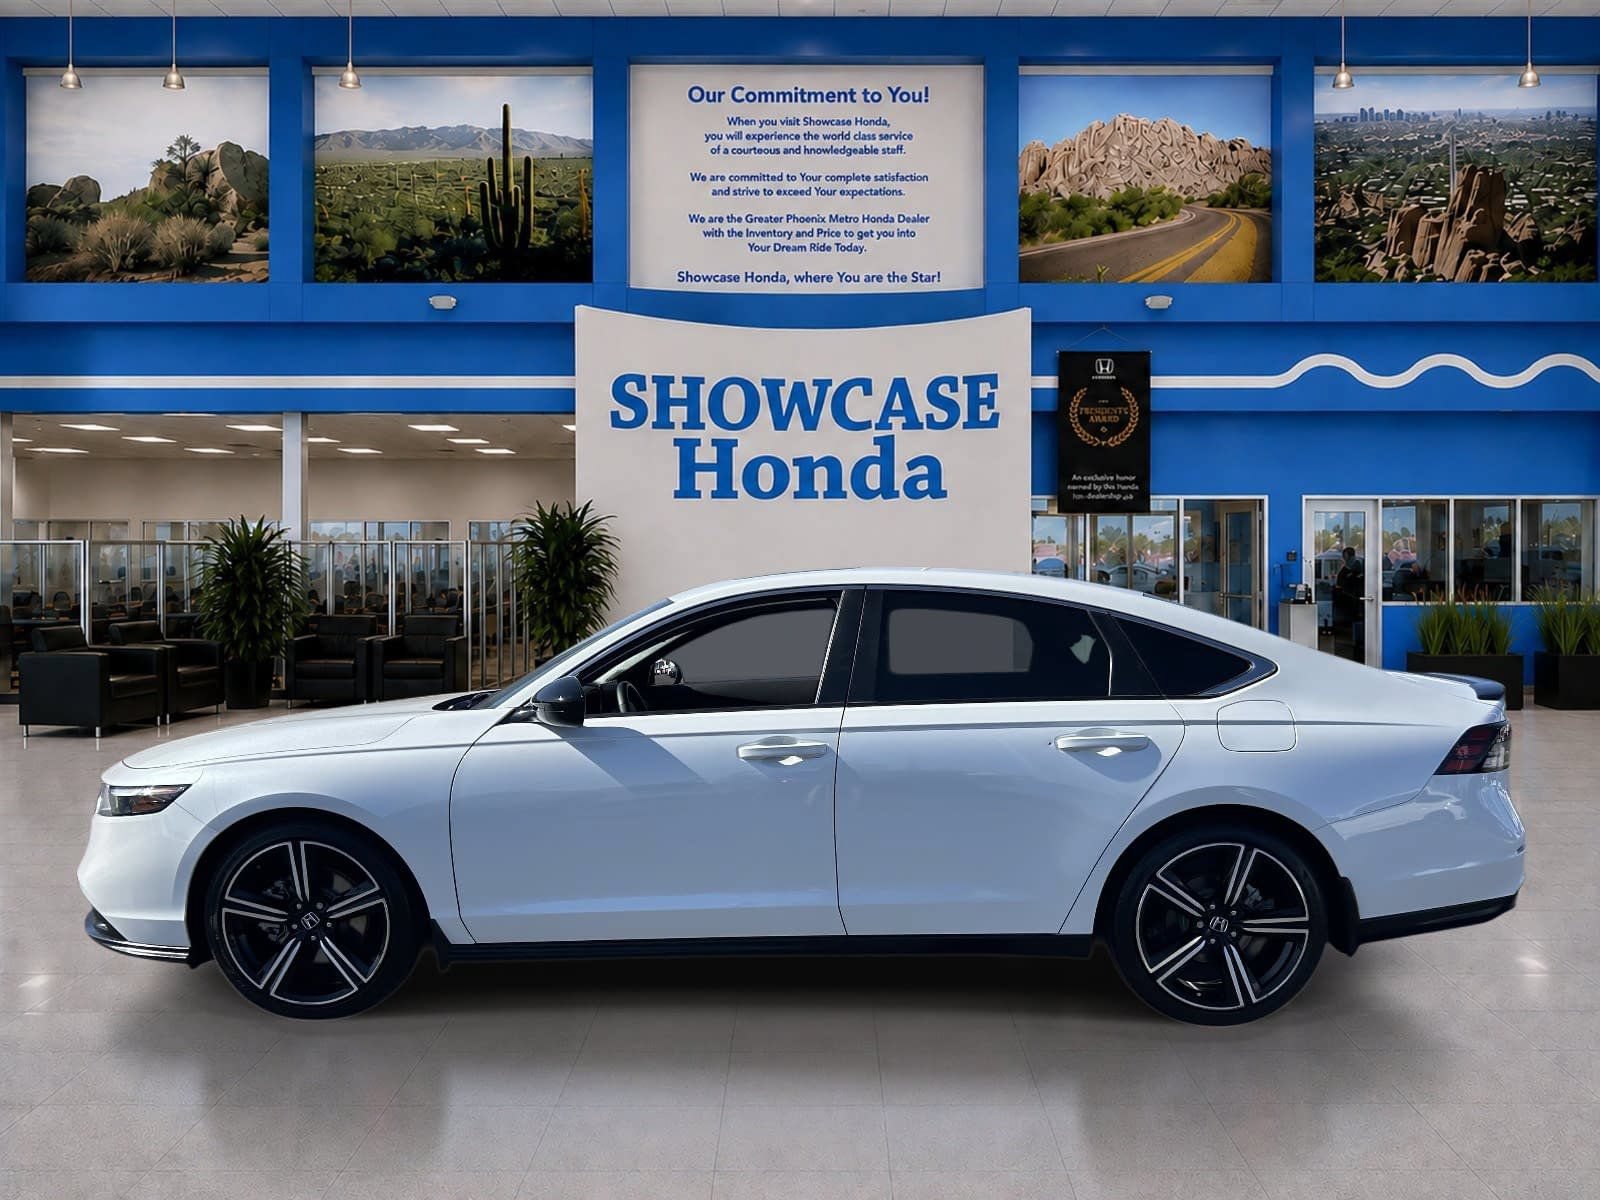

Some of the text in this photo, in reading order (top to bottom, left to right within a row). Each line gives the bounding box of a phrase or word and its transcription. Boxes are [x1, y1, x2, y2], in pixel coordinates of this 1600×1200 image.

[688, 86, 928, 103] Our Commitment to You!
[727, 117, 890, 128] When you visit Showcase Honda,
[705, 131, 913, 143] you will experience the world class service
[710, 145, 720, 154] of
[731, 147, 780, 155] courteous
[783, 145, 801, 154] and
[882, 145, 906, 154] staff.
[690, 173, 707, 182] We
[729, 172, 783, 182] committed
[786, 174, 797, 182] to
[800, 173, 822, 182] Your
[825, 172, 871, 184] complete
[874, 172, 928, 182] satisfaction
[712, 187, 905, 199] and strive to exceed Your expectations.
[689, 214, 706, 224] We
[726, 214, 743, 223] the
[745, 214, 784, 223] Greater
[786, 214, 826, 223] Phoenix
[829, 214, 859, 223] Metro
[862, 214, 894, 223] Honda
[898, 214, 930, 223] Dealer
[703, 228, 916, 240] with the Inventory and Price to get you into
[748, 243, 866, 254] Your Dream Ride Today.
[677, 271, 940, 285] Showcase Honda, where You are the Star!
[610, 373, 1000, 431] SHOWCASE
[673, 434, 948, 500] Honda
